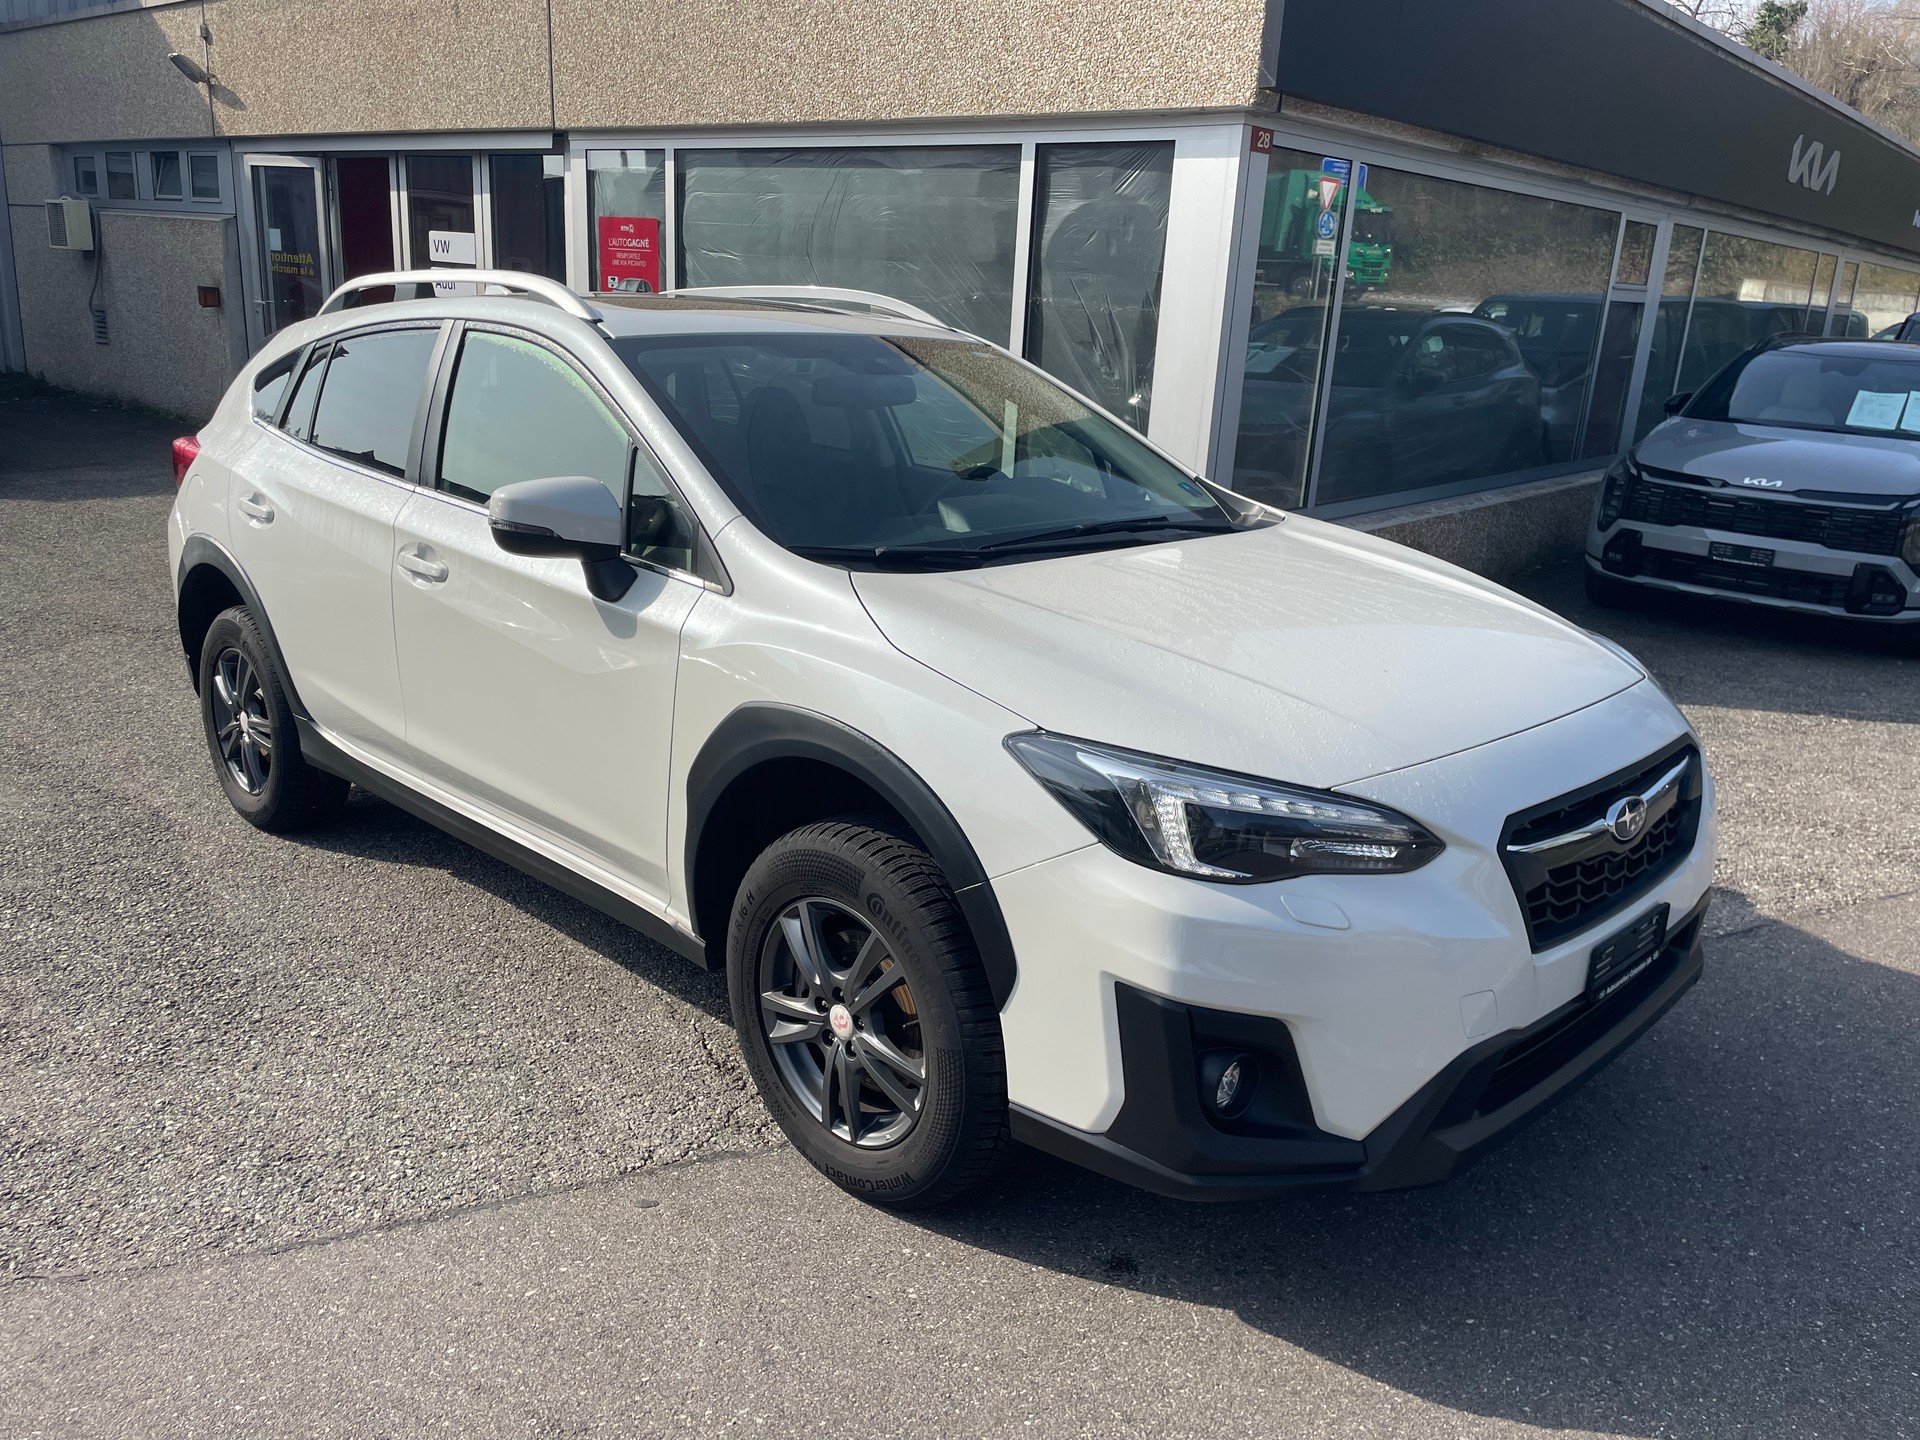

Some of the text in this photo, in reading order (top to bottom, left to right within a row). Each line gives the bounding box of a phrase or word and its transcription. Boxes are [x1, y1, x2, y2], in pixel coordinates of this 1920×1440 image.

[1257, 131, 1271, 149] 28
[433, 239, 450, 254] VW
[608, 237, 650, 248] L'AUTOGAGNÉ
[616, 252, 640, 260] REMPORTEZ
[628, 260, 646, 268] PICANTO
[824, 1162, 916, 1193] WinterContact
